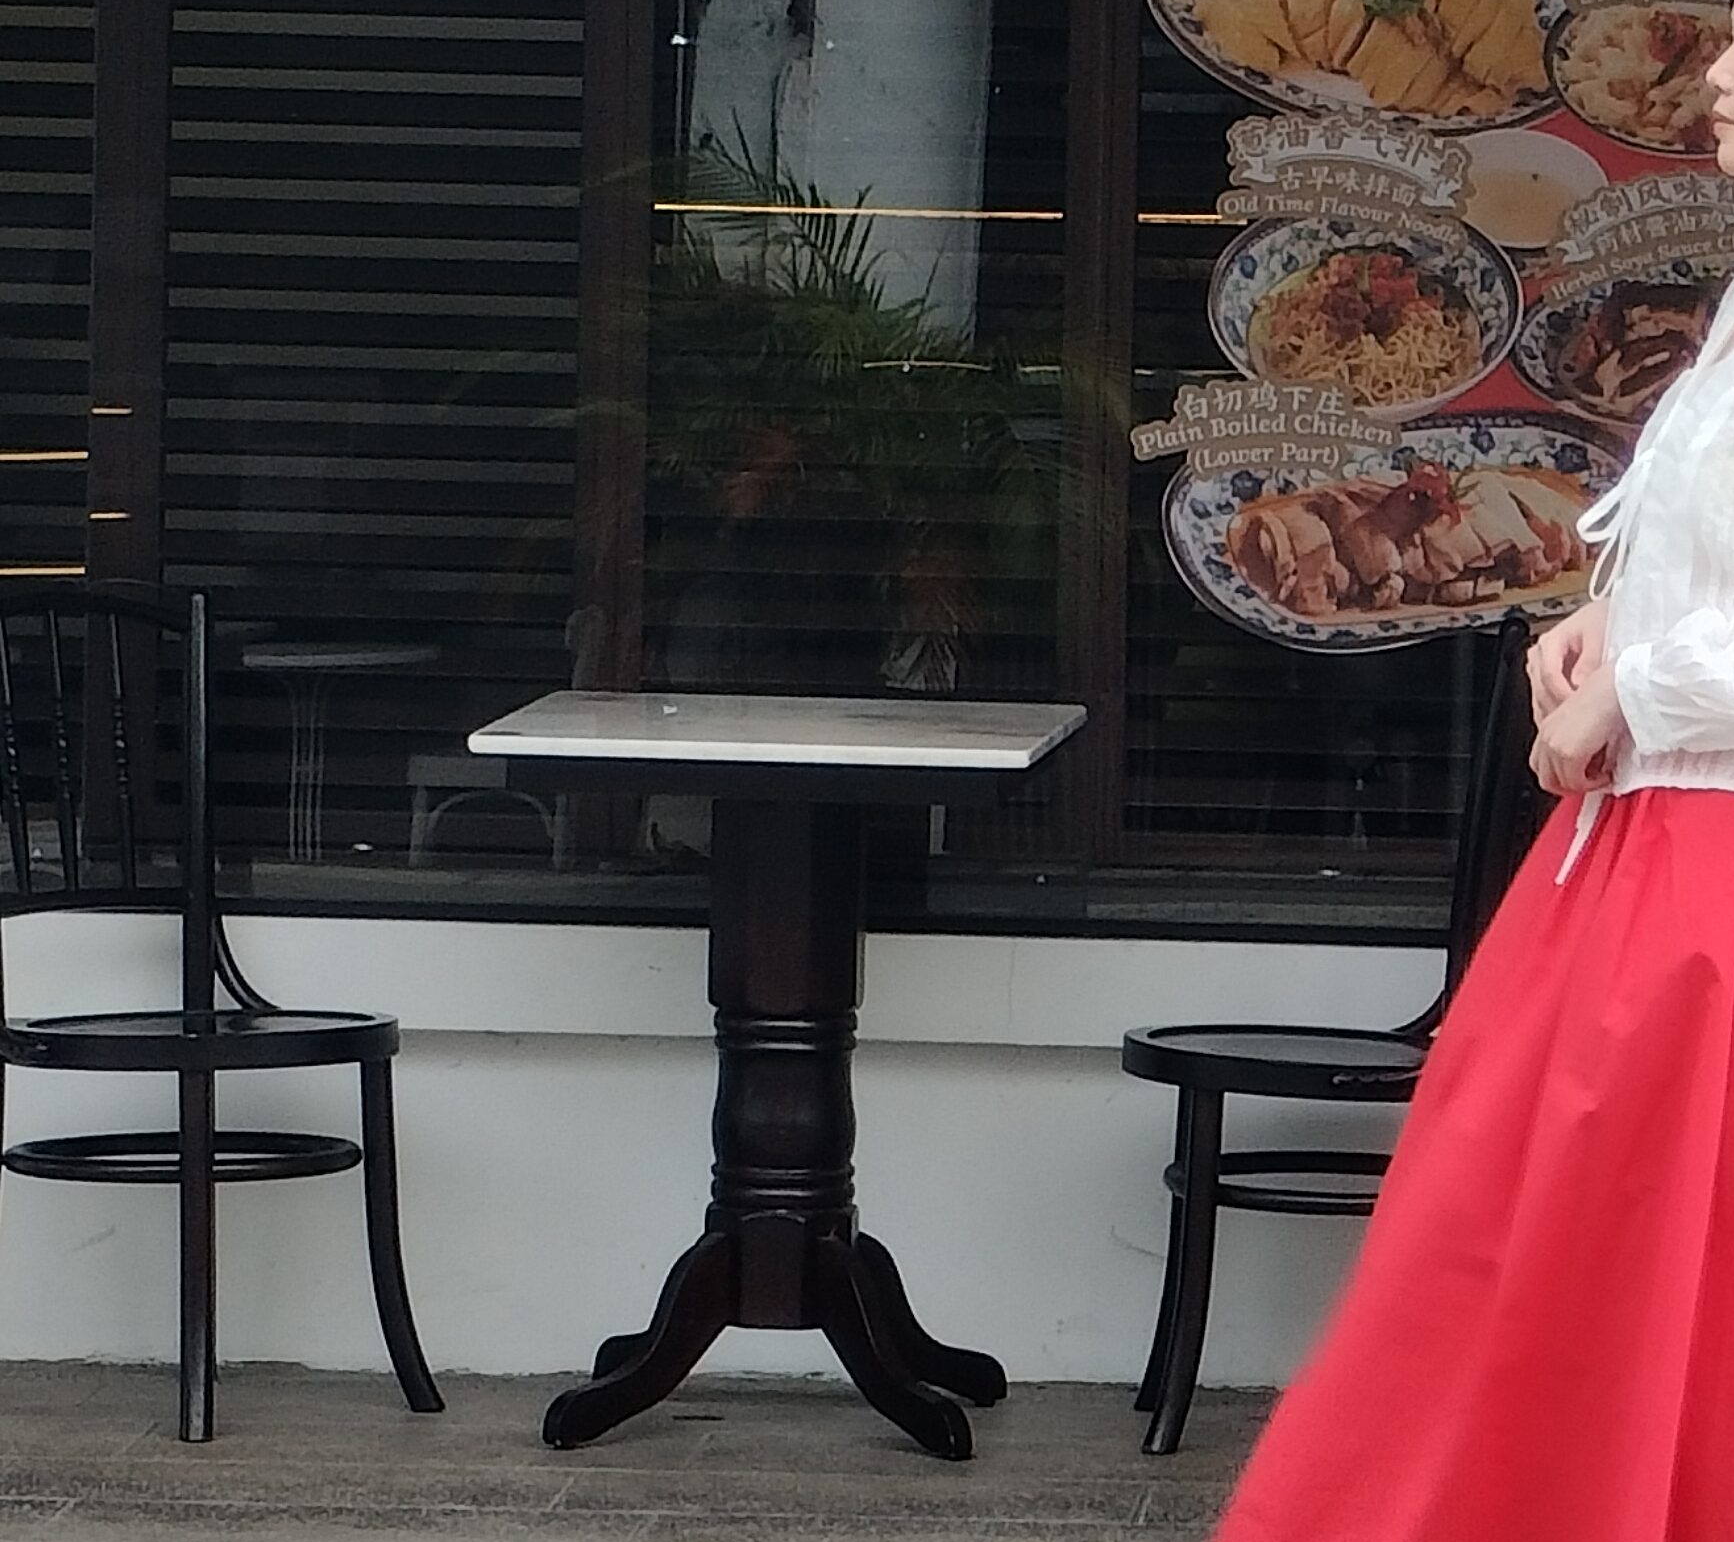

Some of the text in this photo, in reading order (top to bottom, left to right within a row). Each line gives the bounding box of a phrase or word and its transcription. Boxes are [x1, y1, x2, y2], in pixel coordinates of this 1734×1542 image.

[1224, 194, 1462, 245] Old Time Flavour Noodle
[1551, 262, 1608, 300] Herbal
[1657, 240, 1712, 261] Sauce
[1140, 413, 1394, 453] Plain Boiled Chicken
[1194, 444, 1339, 473] (Lower Part)
